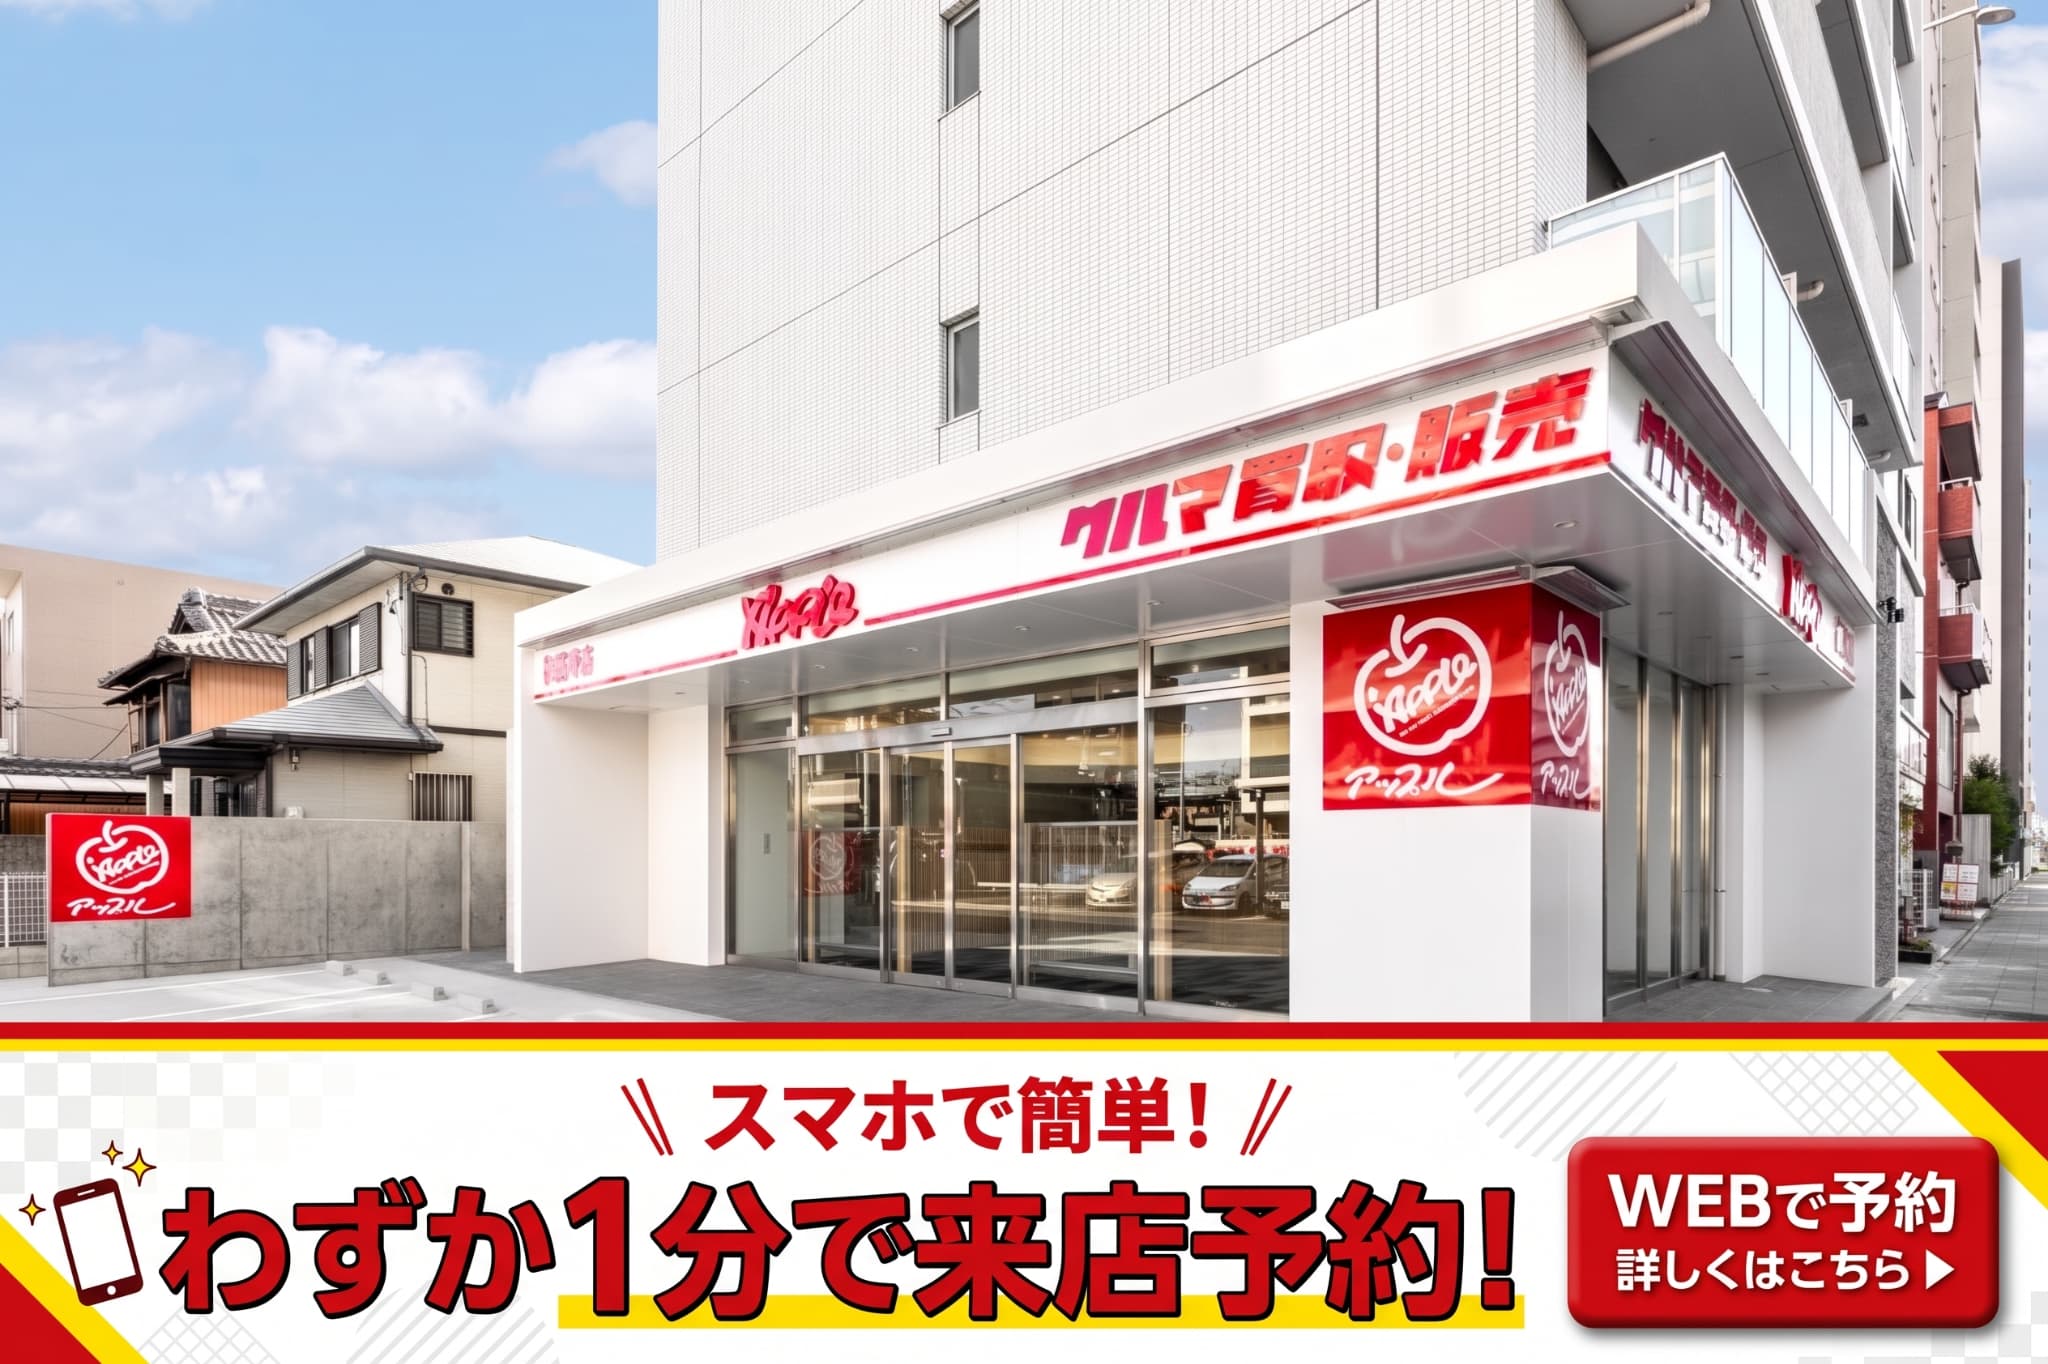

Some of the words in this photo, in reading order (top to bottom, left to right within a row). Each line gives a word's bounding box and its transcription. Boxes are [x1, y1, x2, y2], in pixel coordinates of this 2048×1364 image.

[1060, 367, 1594, 559] クルマ買取・販売
[1344, 761, 1505, 800] アップル
[66, 897, 177, 916] アップル
